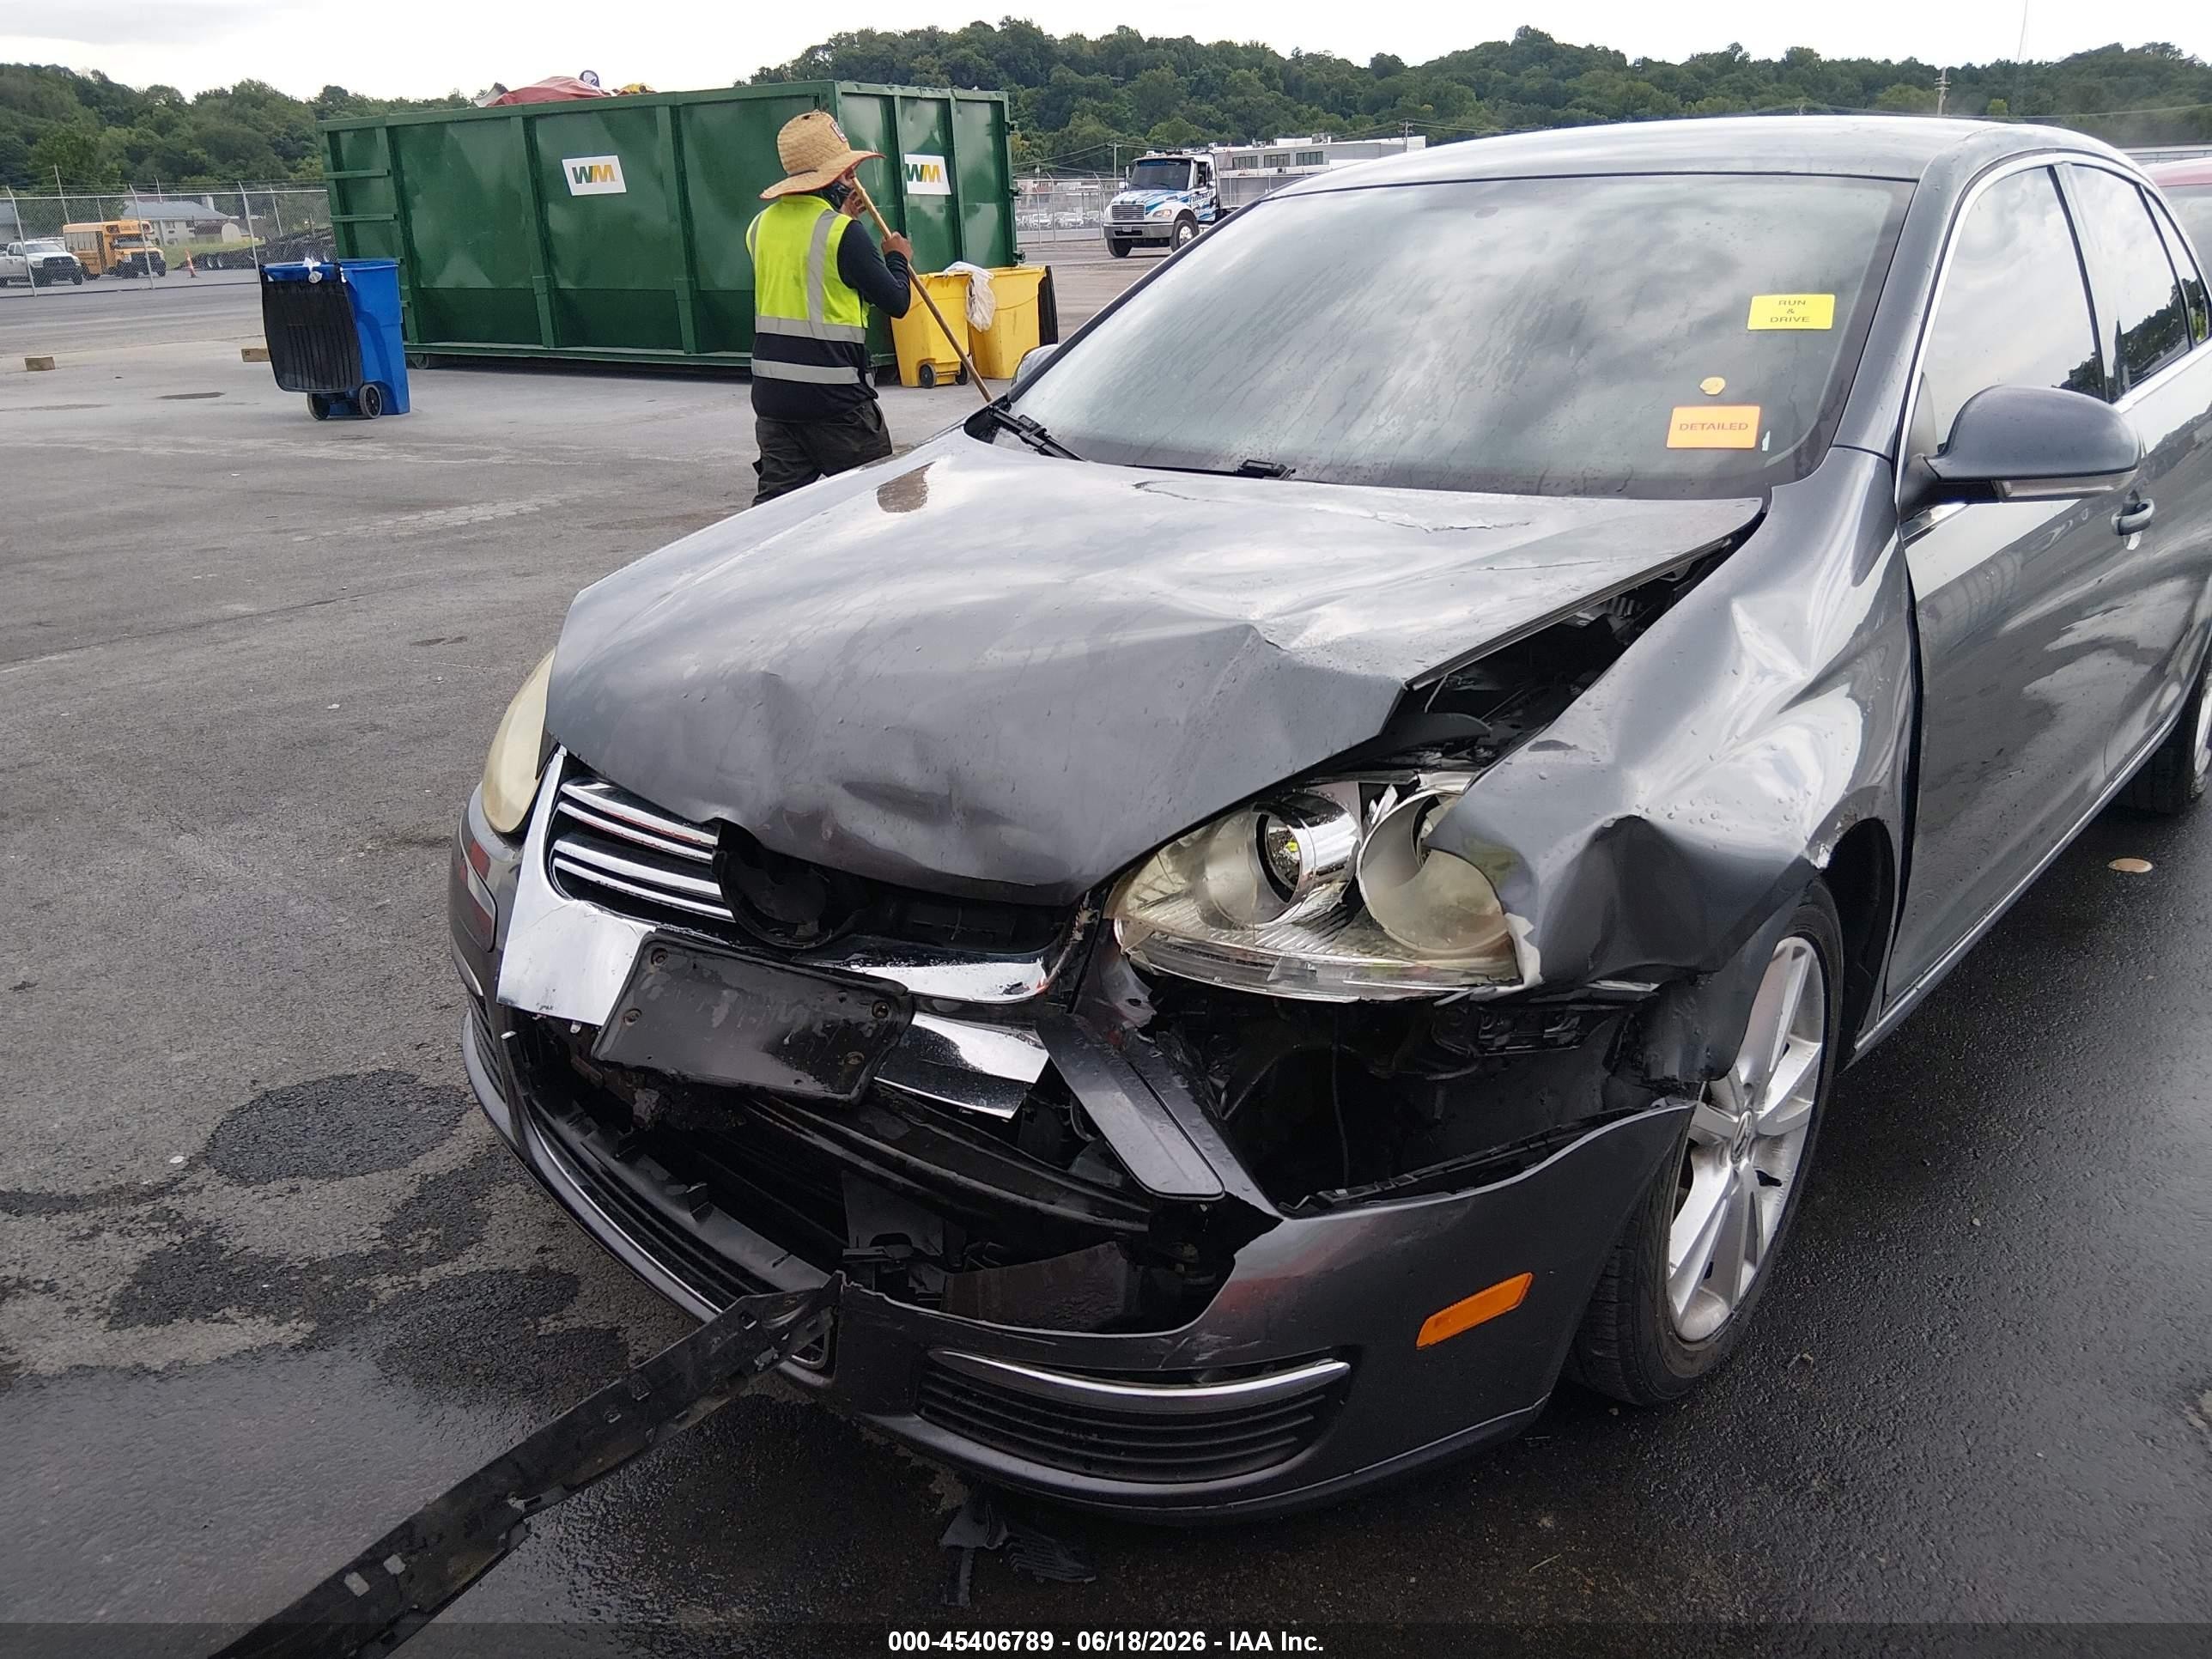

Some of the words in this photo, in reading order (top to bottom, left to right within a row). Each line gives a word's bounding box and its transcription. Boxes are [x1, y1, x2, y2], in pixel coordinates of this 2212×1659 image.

[571, 164, 616, 184] WM
[904, 163, 942, 183] WM
[1679, 422, 1749, 431] DETAILED
